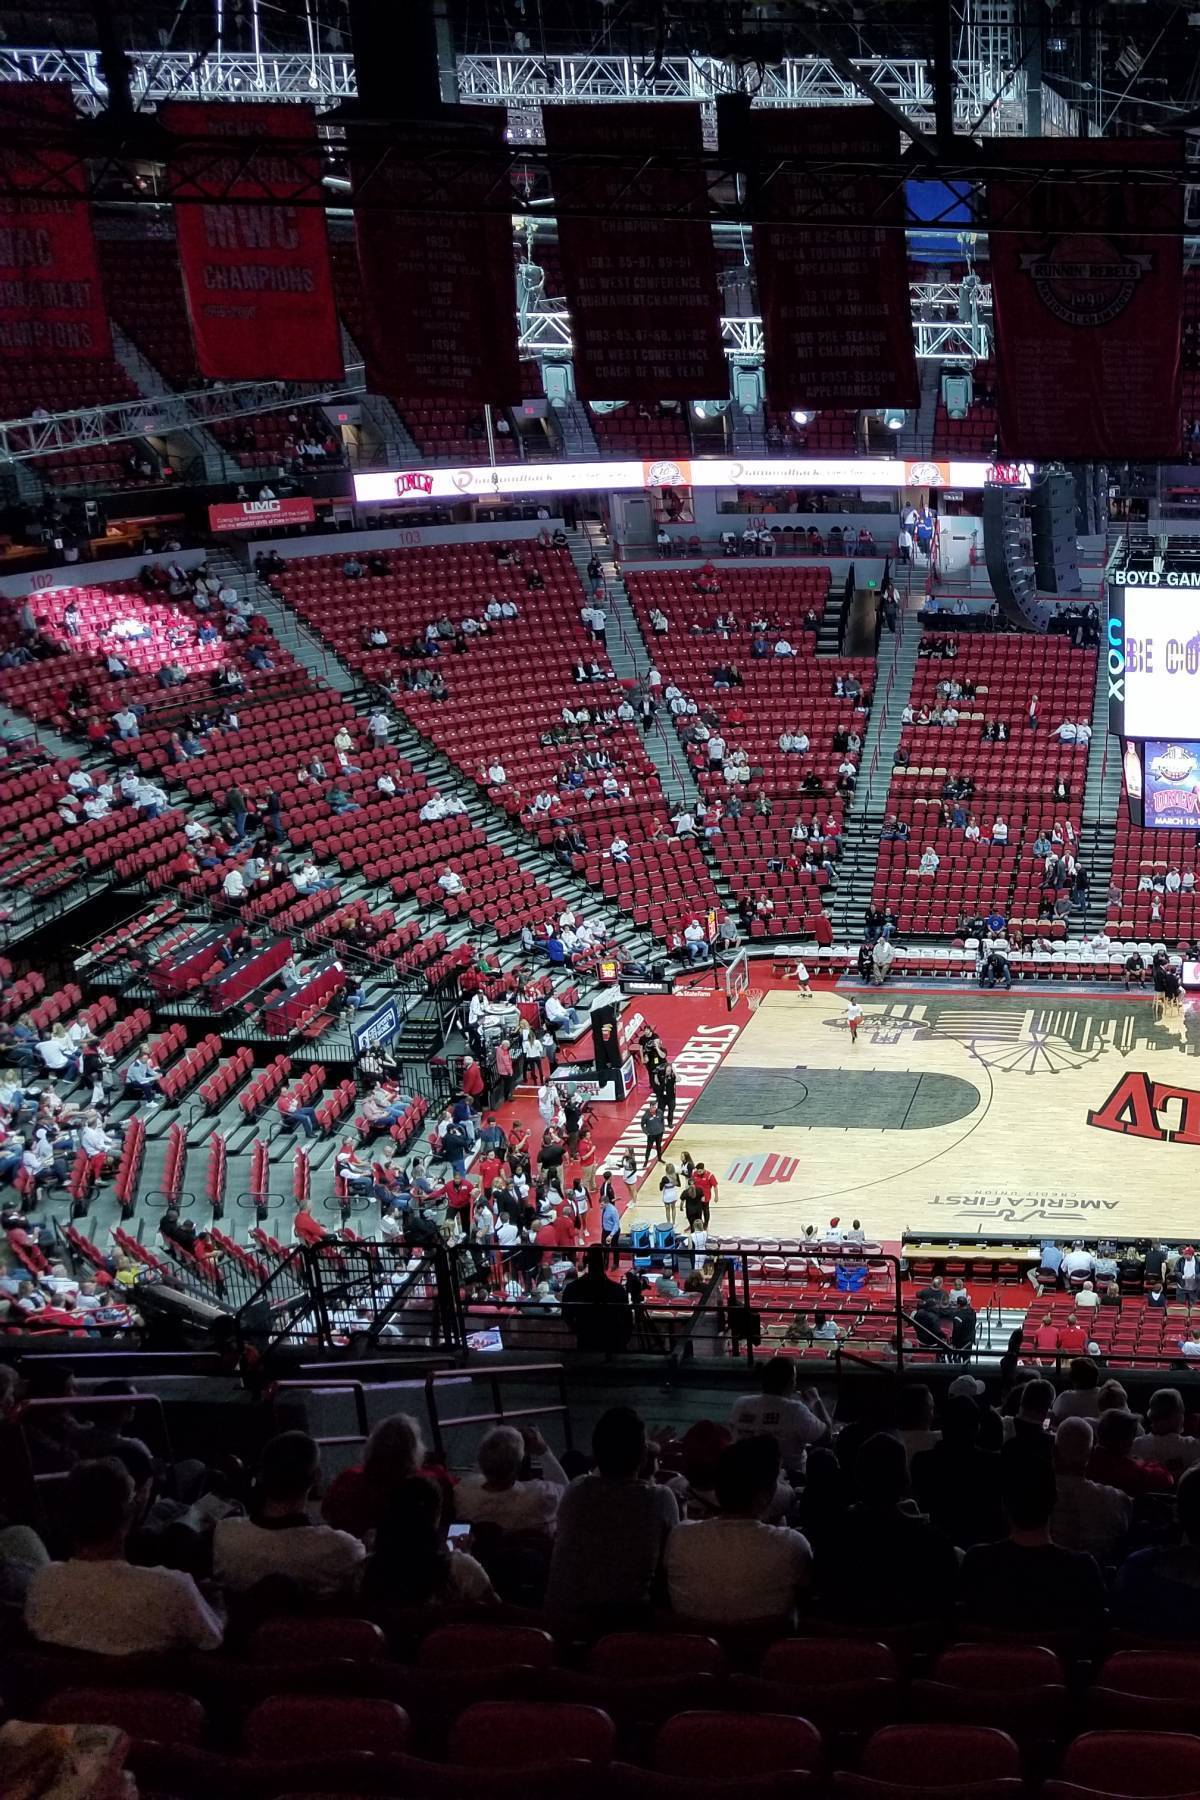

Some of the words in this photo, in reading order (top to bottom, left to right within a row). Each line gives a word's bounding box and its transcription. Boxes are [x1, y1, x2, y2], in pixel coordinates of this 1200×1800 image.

[203, 205, 300, 250] MWC
[203, 264, 314, 292] CHAMPIONS
[1034, 264, 1085, 277] RUNNIN'
[1089, 265, 1138, 278] REBELS
[394, 472, 434, 497] UNLV
[242, 499, 281, 514] UMC
[398, 532, 422, 546] 103
[30, 574, 54, 591] 102
[1115, 571, 1161, 586] BOYD
[1107, 617, 1126, 702] COX
[1126, 637, 1154, 674] BE
[1155, 817, 1184, 825] MARCH
[629, 982, 663, 990] NISSAN
[927, 1195, 1001, 1207] FIRST
[1006, 1197, 1121, 1210] AMERICA
